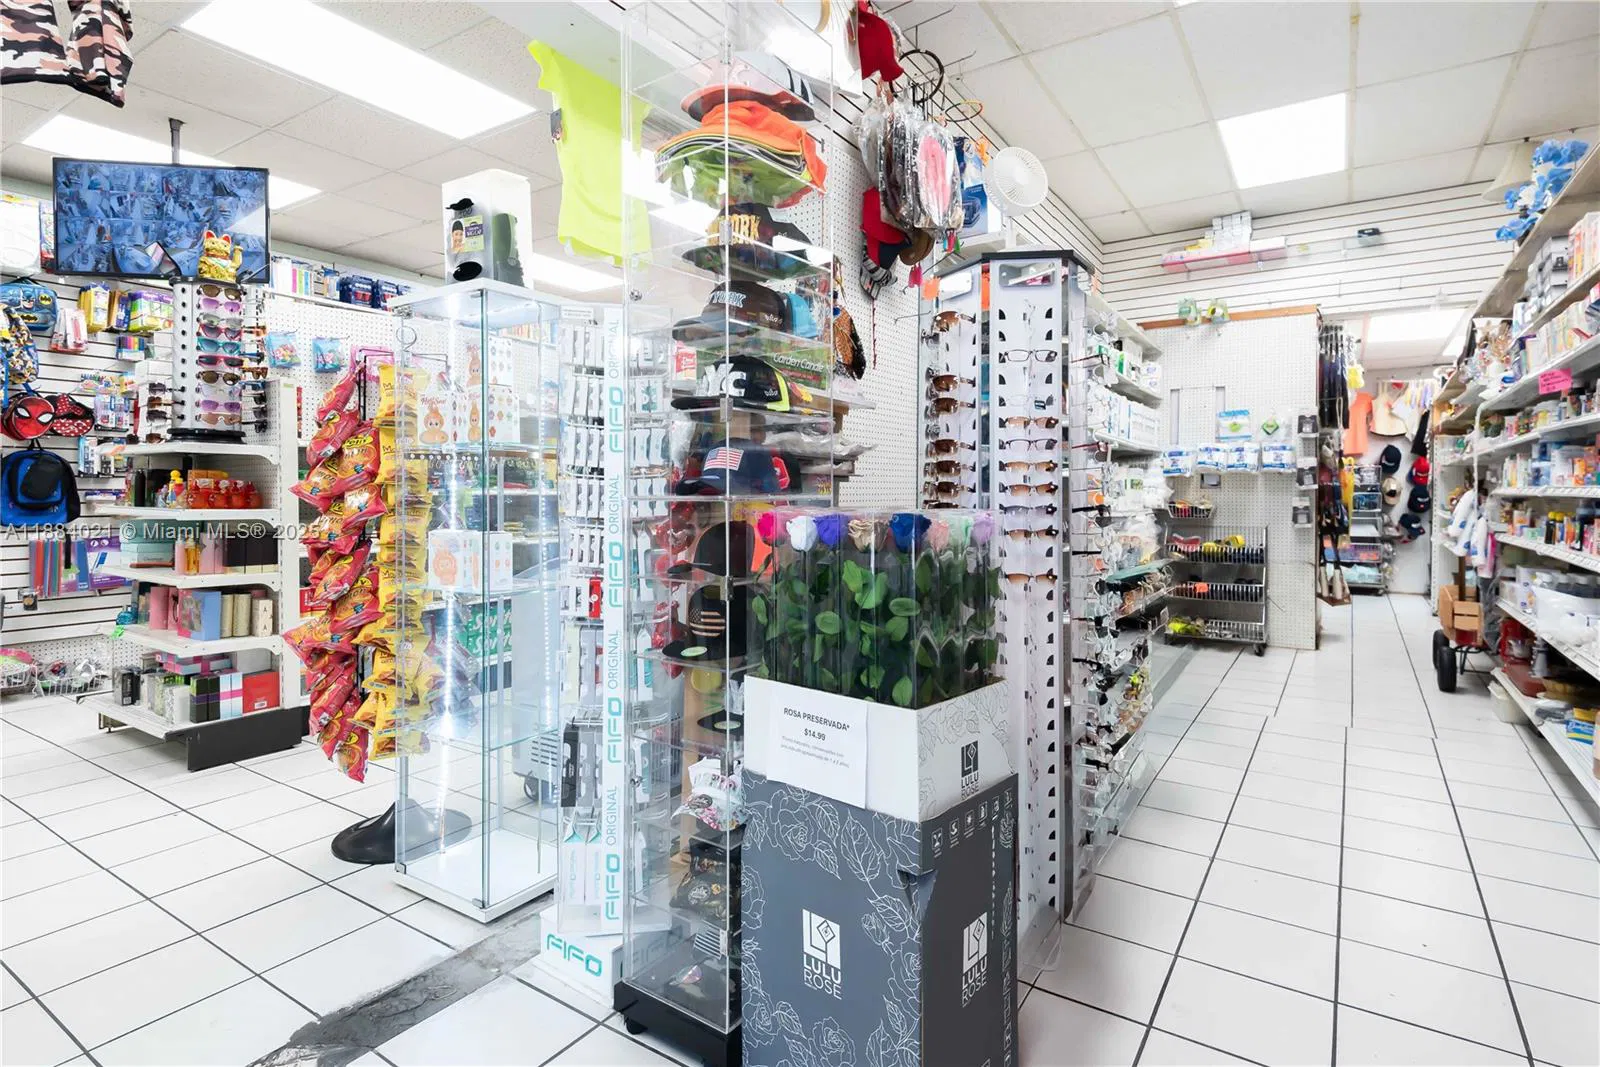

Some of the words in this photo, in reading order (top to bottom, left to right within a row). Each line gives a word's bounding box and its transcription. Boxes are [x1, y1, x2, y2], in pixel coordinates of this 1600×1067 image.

[608, 386, 624, 453] FIFO
[608, 473, 620, 535] ORIGINAL
[608, 541, 624, 608] FIFO
[608, 632, 619, 690] ORIGINAL
[607, 697, 622, 763] FIFO
[783, 707, 801, 719] ROSA
[804, 728, 826, 741] $14.99
[960, 782, 979, 801] ROSE
[961, 771, 978, 789] LULU
[606, 786, 617, 846] ORIGINAL
[605, 853, 621, 920] FIFO
[546, 933, 603, 977] FIFO
[803, 953, 842, 984] LULU
[962, 955, 988, 990] LULU
[803, 968, 843, 1000] ROSE
[962, 970, 988, 1005] ROSE
